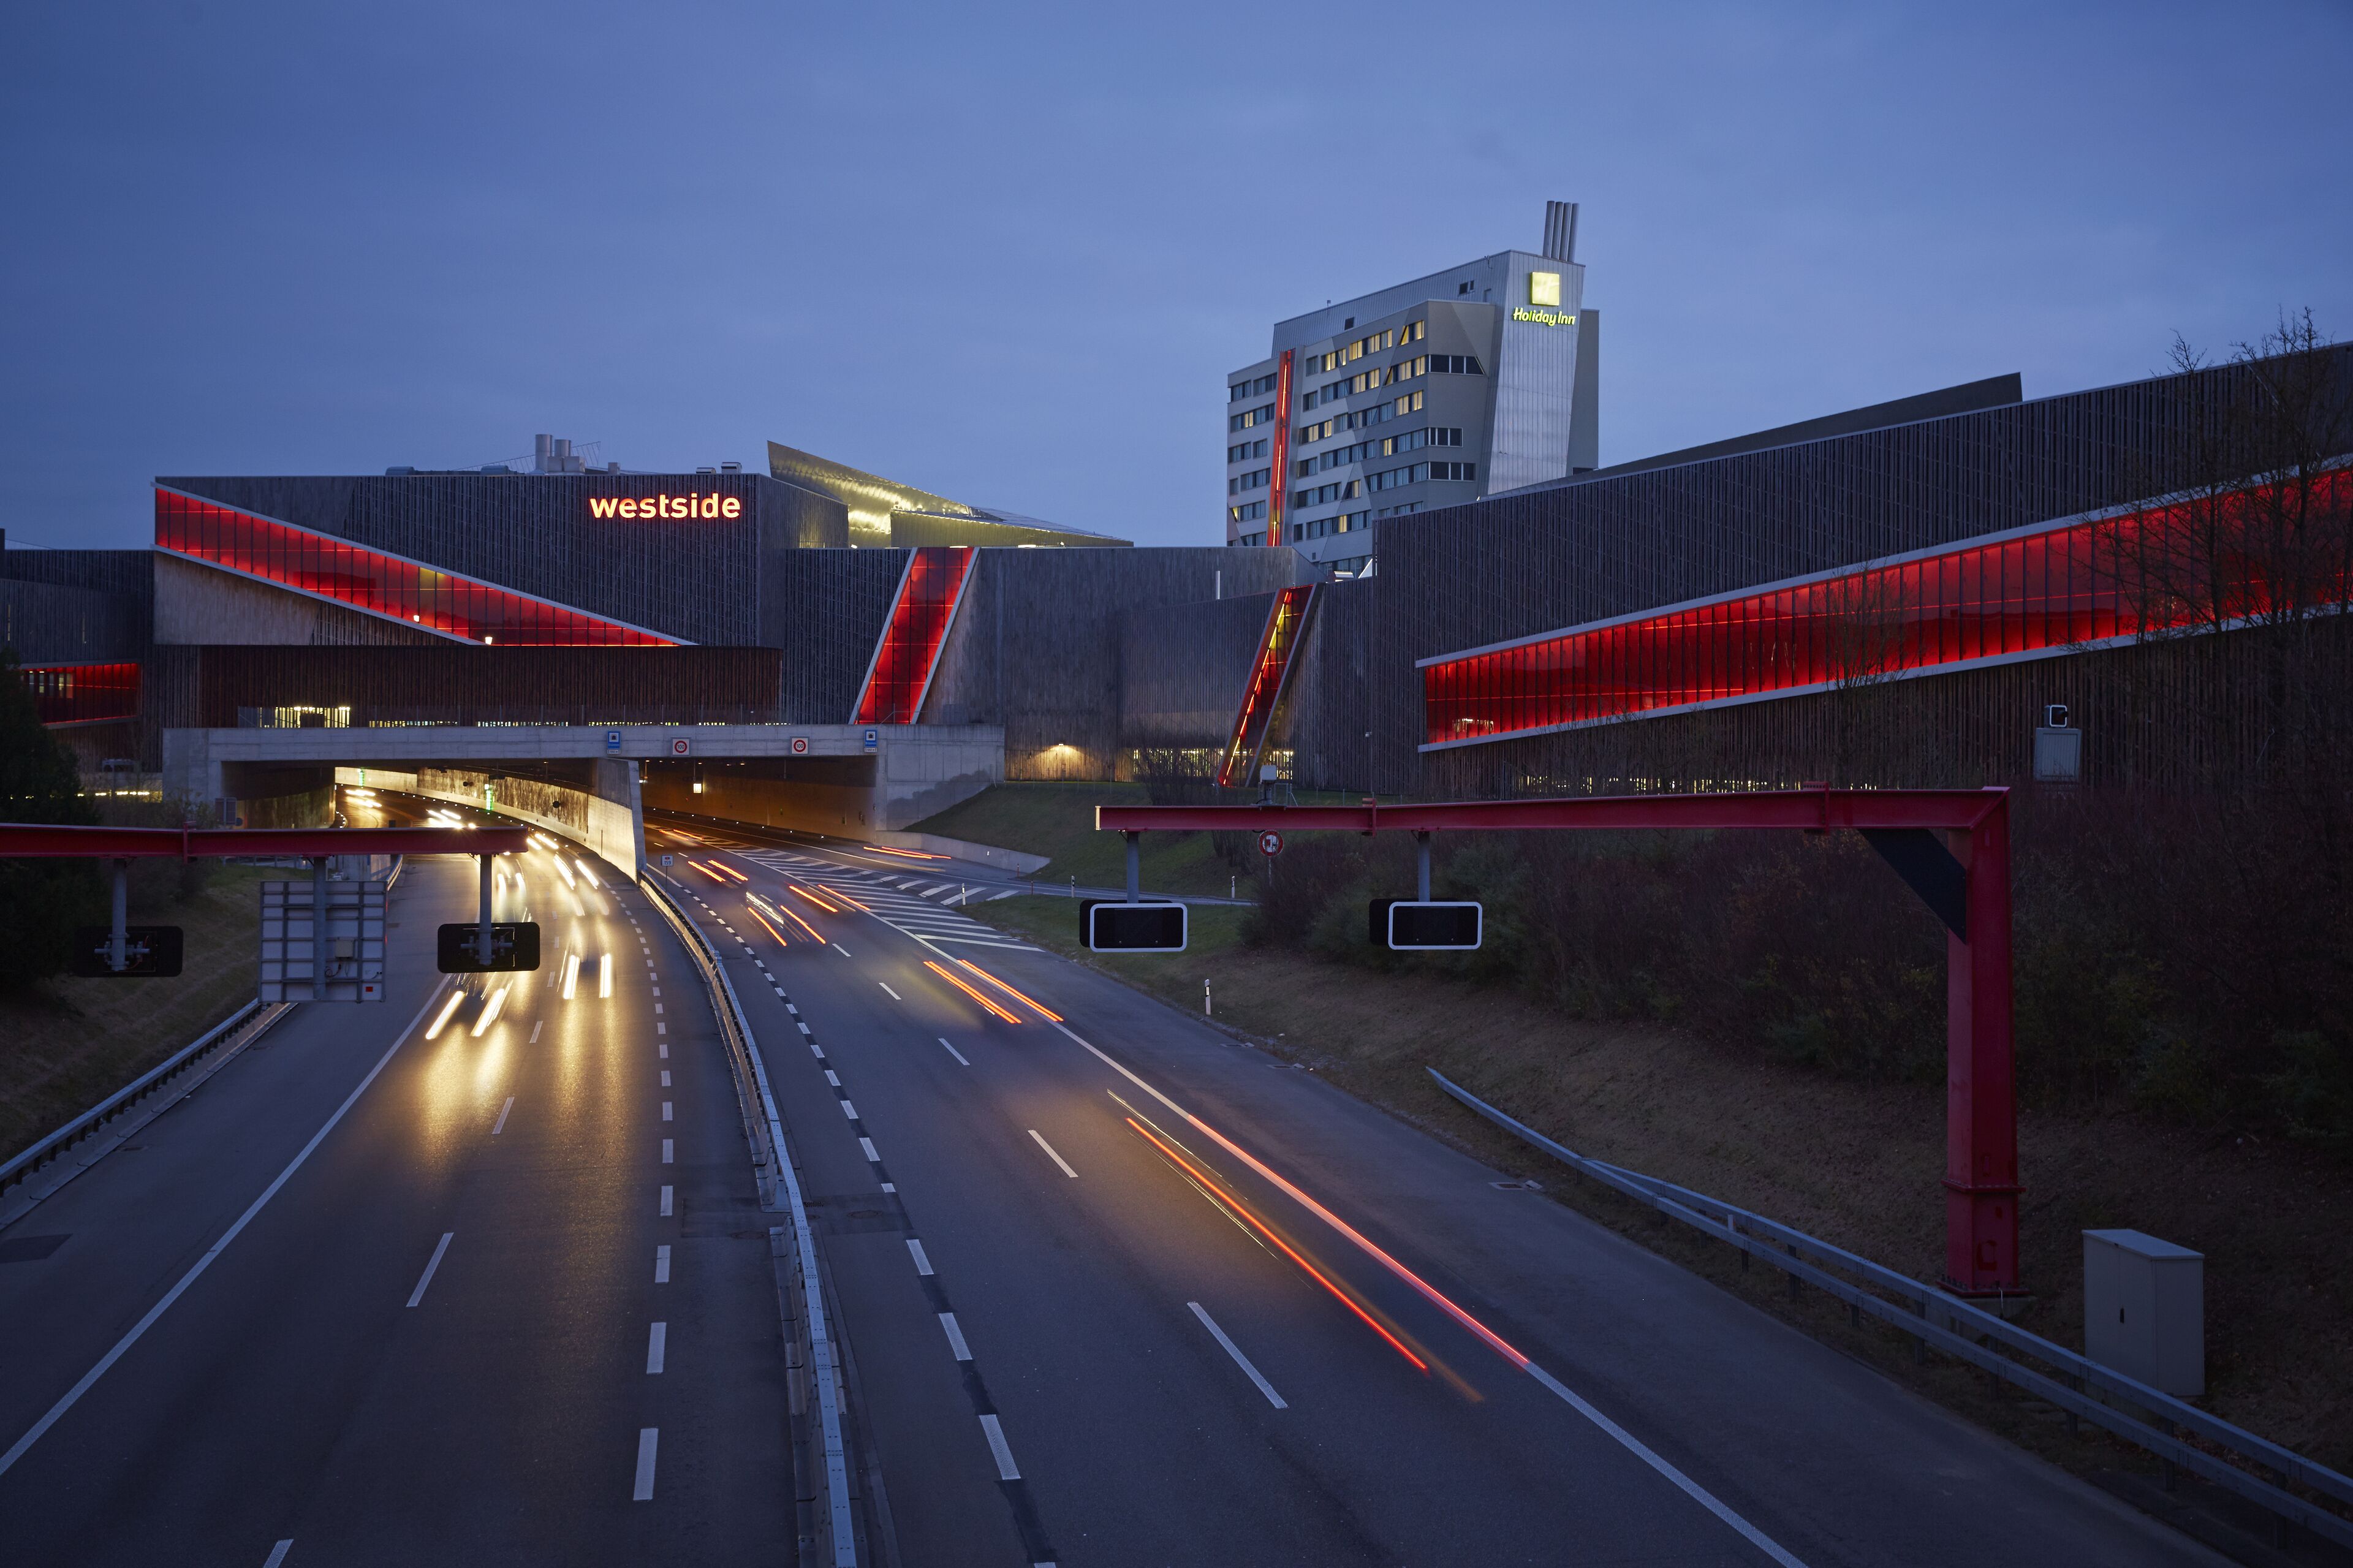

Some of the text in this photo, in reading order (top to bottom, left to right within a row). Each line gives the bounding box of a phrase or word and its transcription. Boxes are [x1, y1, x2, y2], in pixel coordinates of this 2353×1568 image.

[1513, 307, 1575, 326] Holiday Inn
[589, 493, 740, 518] westside
